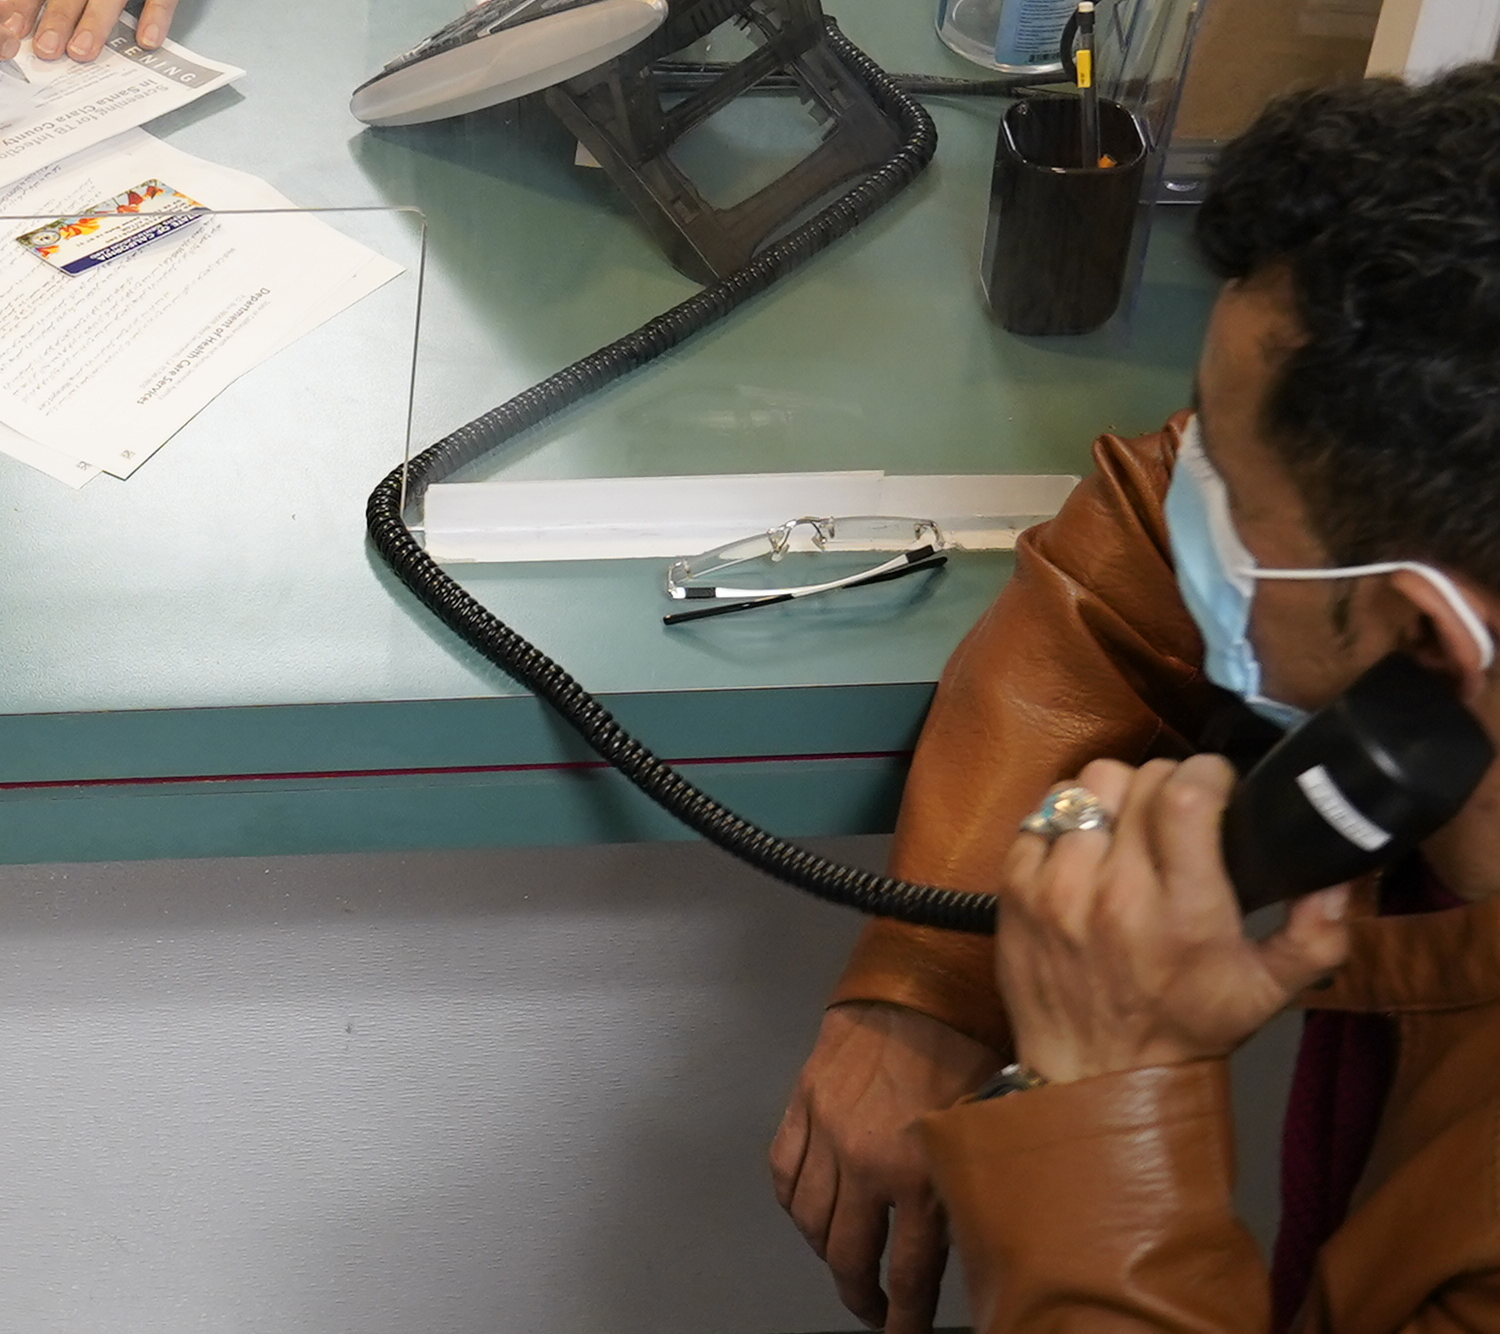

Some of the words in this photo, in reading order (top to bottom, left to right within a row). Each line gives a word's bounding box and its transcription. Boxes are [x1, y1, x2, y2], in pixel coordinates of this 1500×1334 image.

[96, 82, 140, 110] Santa
[97, 81, 169, 121] Screening
[55, 100, 97, 128] Clara
[74, 110, 98, 130] for
[1, 116, 56, 151] County
[54, 120, 75, 137] TB
[221, 286, 271, 330] Department
[187, 336, 215, 360] Health
[170, 358, 190, 377] Care
[137, 375, 173, 405] Services
